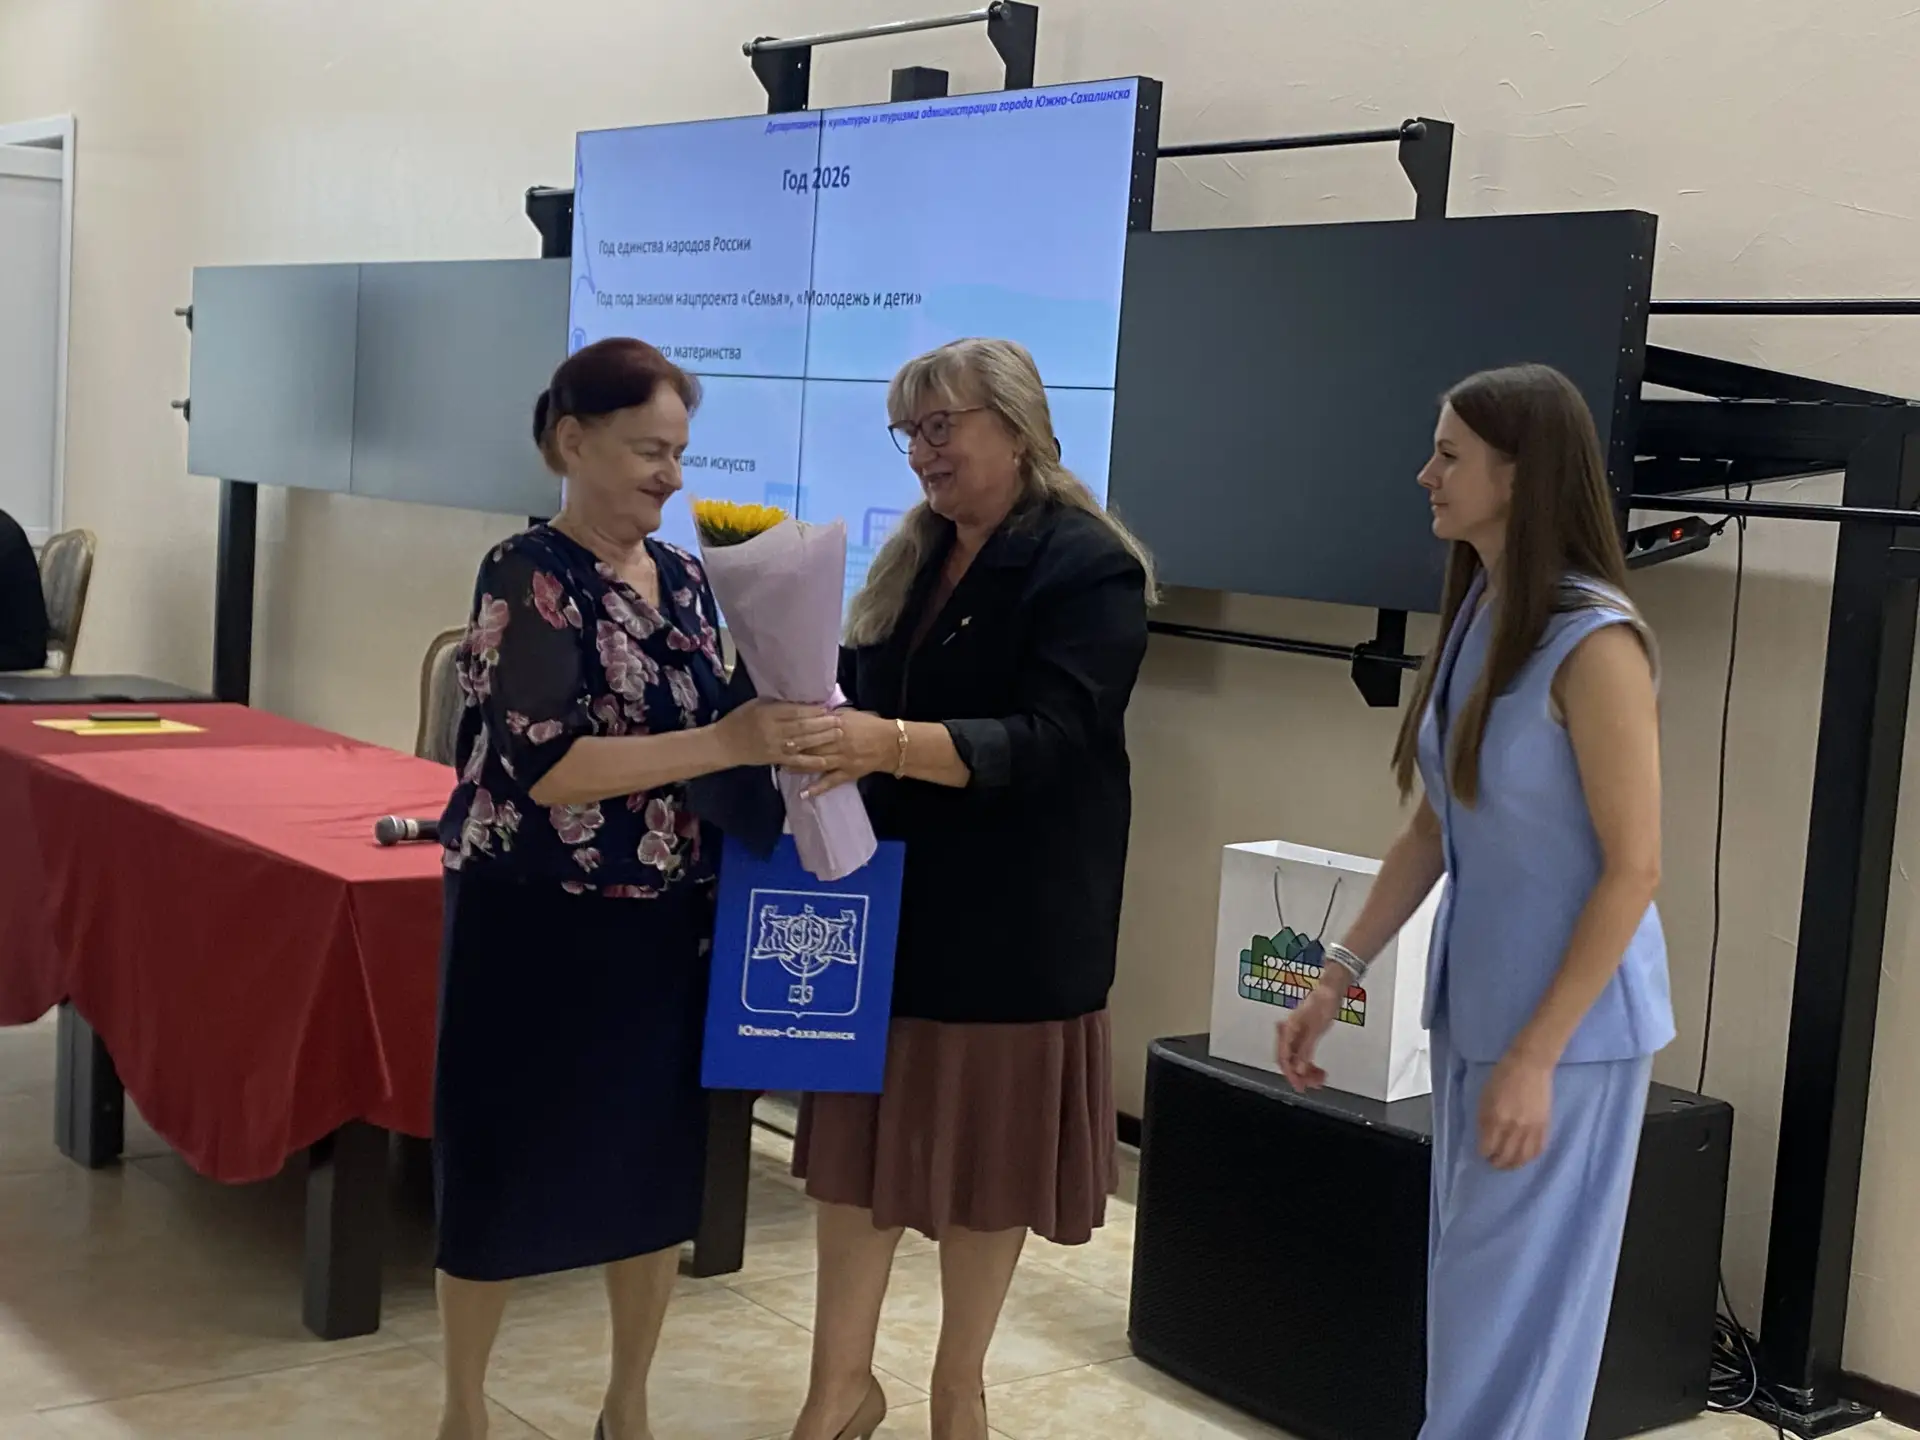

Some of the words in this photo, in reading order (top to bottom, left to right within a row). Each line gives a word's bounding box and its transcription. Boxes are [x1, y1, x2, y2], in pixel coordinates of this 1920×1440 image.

[921, 103, 997, 119] администрации
[998, 96, 1033, 113] города
[1034, 88, 1131, 108] Южно-Сахалинска
[782, 168, 808, 195] Год
[811, 165, 850, 189] 2026
[599, 239, 616, 256] Год
[617, 239, 663, 256] единства
[665, 239, 711, 255] народов
[712, 236, 752, 252] России
[597, 290, 613, 308] Год
[615, 293, 634, 309] под
[636, 292, 674, 306] знаком
[676, 292, 738, 309] нацпроекта
[741, 290, 794, 308] «Семья»,
[797, 290, 870, 309] «Молодежь
[872, 292, 881, 306] и
[883, 292, 922, 309] дети»
[673, 346, 742, 361] материнства
[681, 456, 708, 469] школ
[710, 457, 756, 474] искусств
[1262, 954, 1321, 980] ЮЖНО
[738, 1024, 856, 1040] Южно-Сахалинск
